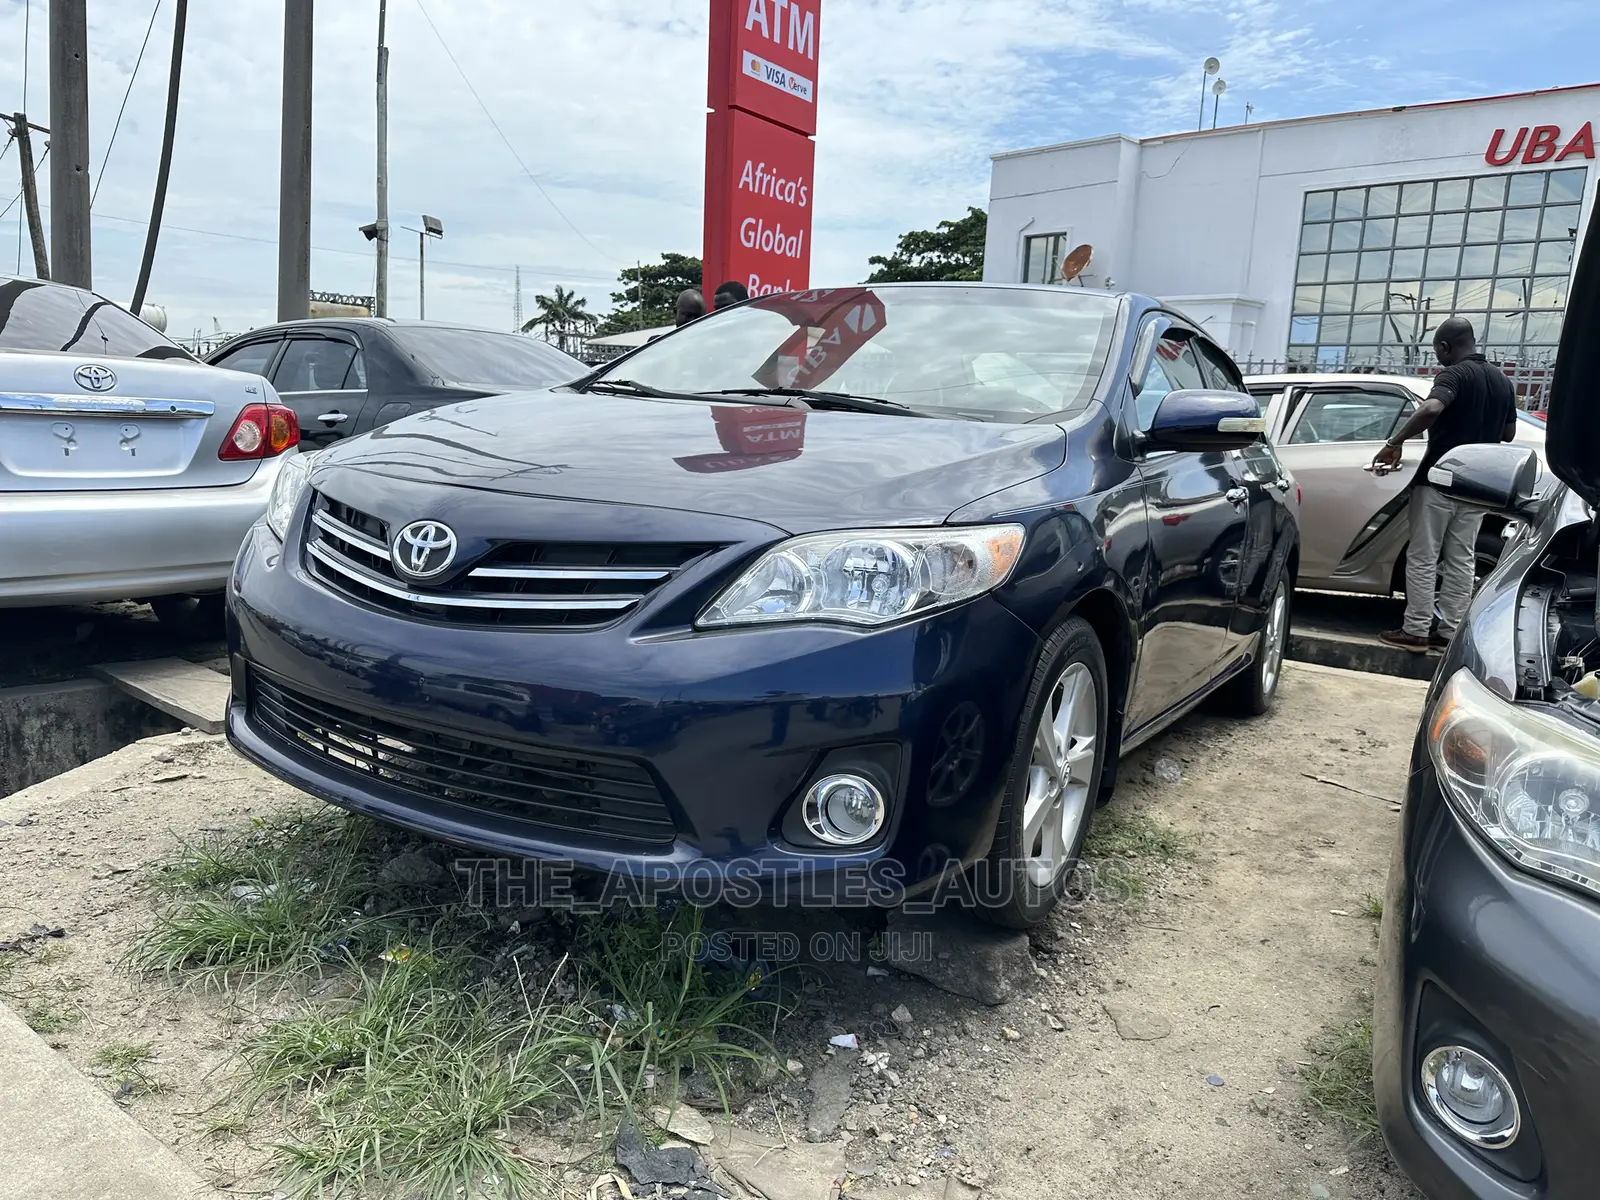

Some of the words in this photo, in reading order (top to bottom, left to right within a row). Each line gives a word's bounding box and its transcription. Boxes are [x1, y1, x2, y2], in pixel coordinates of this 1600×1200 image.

[745, 0, 814, 61] ATM
[764, 64, 786, 88] VISA
[788, 76, 807, 95] Verve
[1485, 121, 1595, 166] UBA
[738, 159, 807, 207] Africa's
[740, 217, 803, 259] Global
